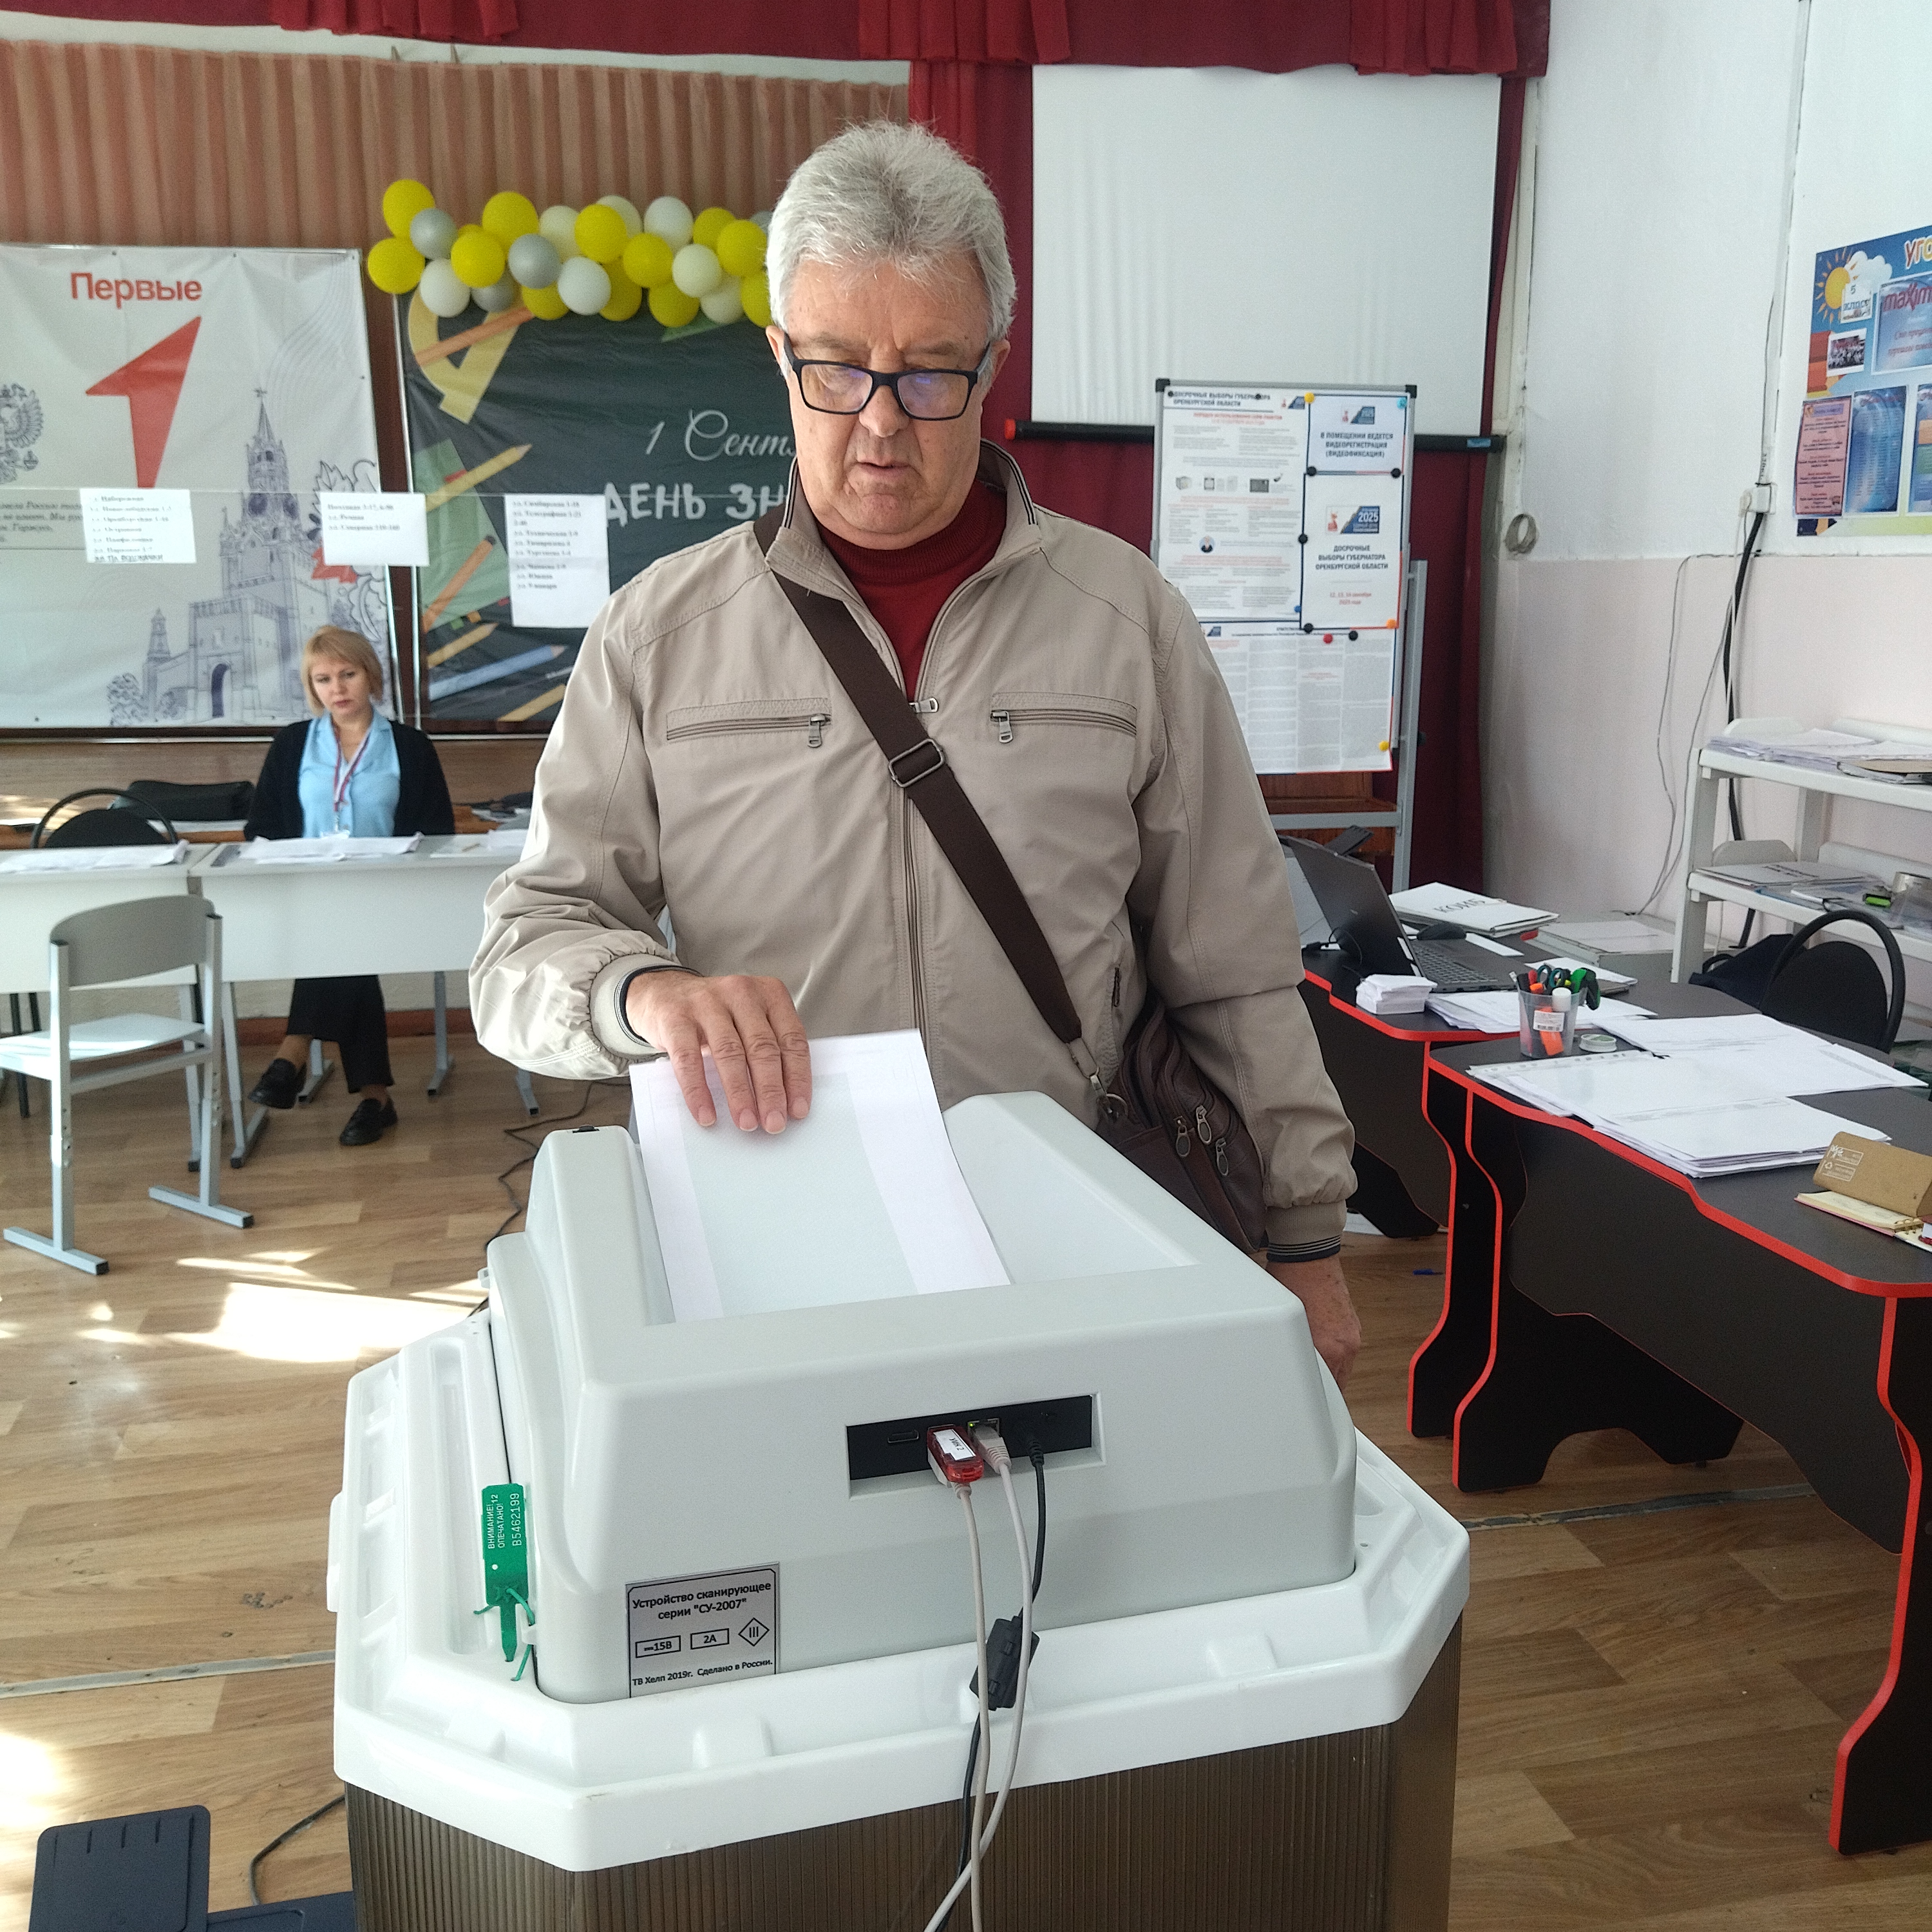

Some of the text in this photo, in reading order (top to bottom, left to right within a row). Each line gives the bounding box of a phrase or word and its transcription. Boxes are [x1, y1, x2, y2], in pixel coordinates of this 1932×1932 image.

[70, 272, 202, 309] Первые
[645, 409, 797, 462] 1 Сент
[605, 482, 706, 527] ДЕНЬ
[1358, 511, 1379, 523] 2025
[486, 1503, 495, 1549] ВНИМАНИЕ!
[496, 1503, 506, 1548] ОПЕЧАТАНО!
[632, 1582, 772, 1609] Устройство сканирующее
[658, 1598, 747, 1620] серии "СУ-2007"
[703, 1634, 717, 1644] 2А
[645, 1676, 665, 1685] Хелп
[667, 1671, 693, 1681] 2019г.
[697, 1665, 733, 1676] Сделано
[742, 1659, 773, 1669] России.
